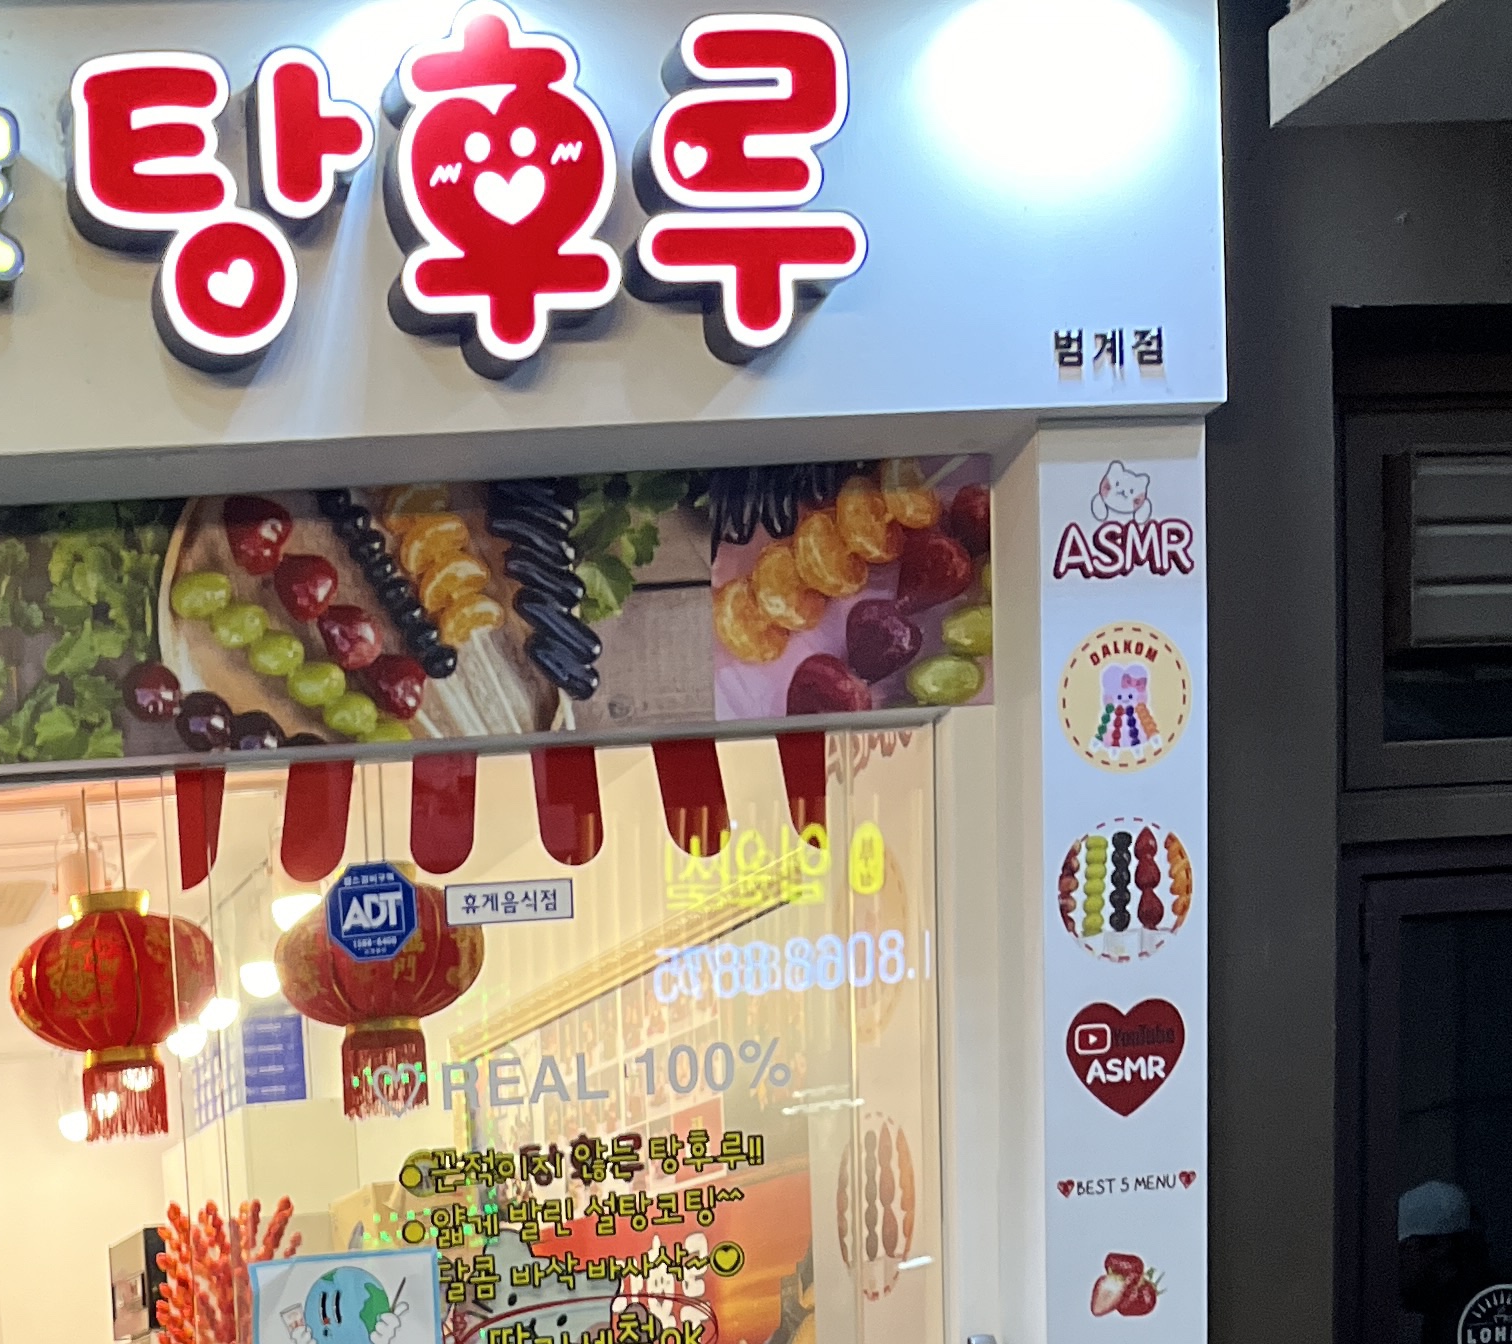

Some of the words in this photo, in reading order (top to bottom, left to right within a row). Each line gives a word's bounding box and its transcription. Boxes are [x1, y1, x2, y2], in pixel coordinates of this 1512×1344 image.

[68, 0, 869, 362] 탕후루
[1053, 327, 1167, 368] 범계점
[1053, 518, 1195, 579] ASMR
[1089, 640, 1159, 666] DALKOM
[342, 891, 403, 931] ADT
[461, 889, 558, 914] 휴게음식점
[442, 1051, 610, 1111] REAL
[633, 1037, 792, 1096] 100%
[1087, 1056, 1167, 1084] ASMR
[648, 1128, 765, 1174] 탕후루!!
[1077, 1179, 1116, 1197] BEST
[1120, 1177, 1131, 1193] 5
[1134, 1174, 1177, 1192] MENU
[432, 1204, 500, 1249] 얇게
[508, 1198, 574, 1242] 발린
[438, 1254, 500, 1304] 달콤
[511, 1251, 578, 1291] 바삭
